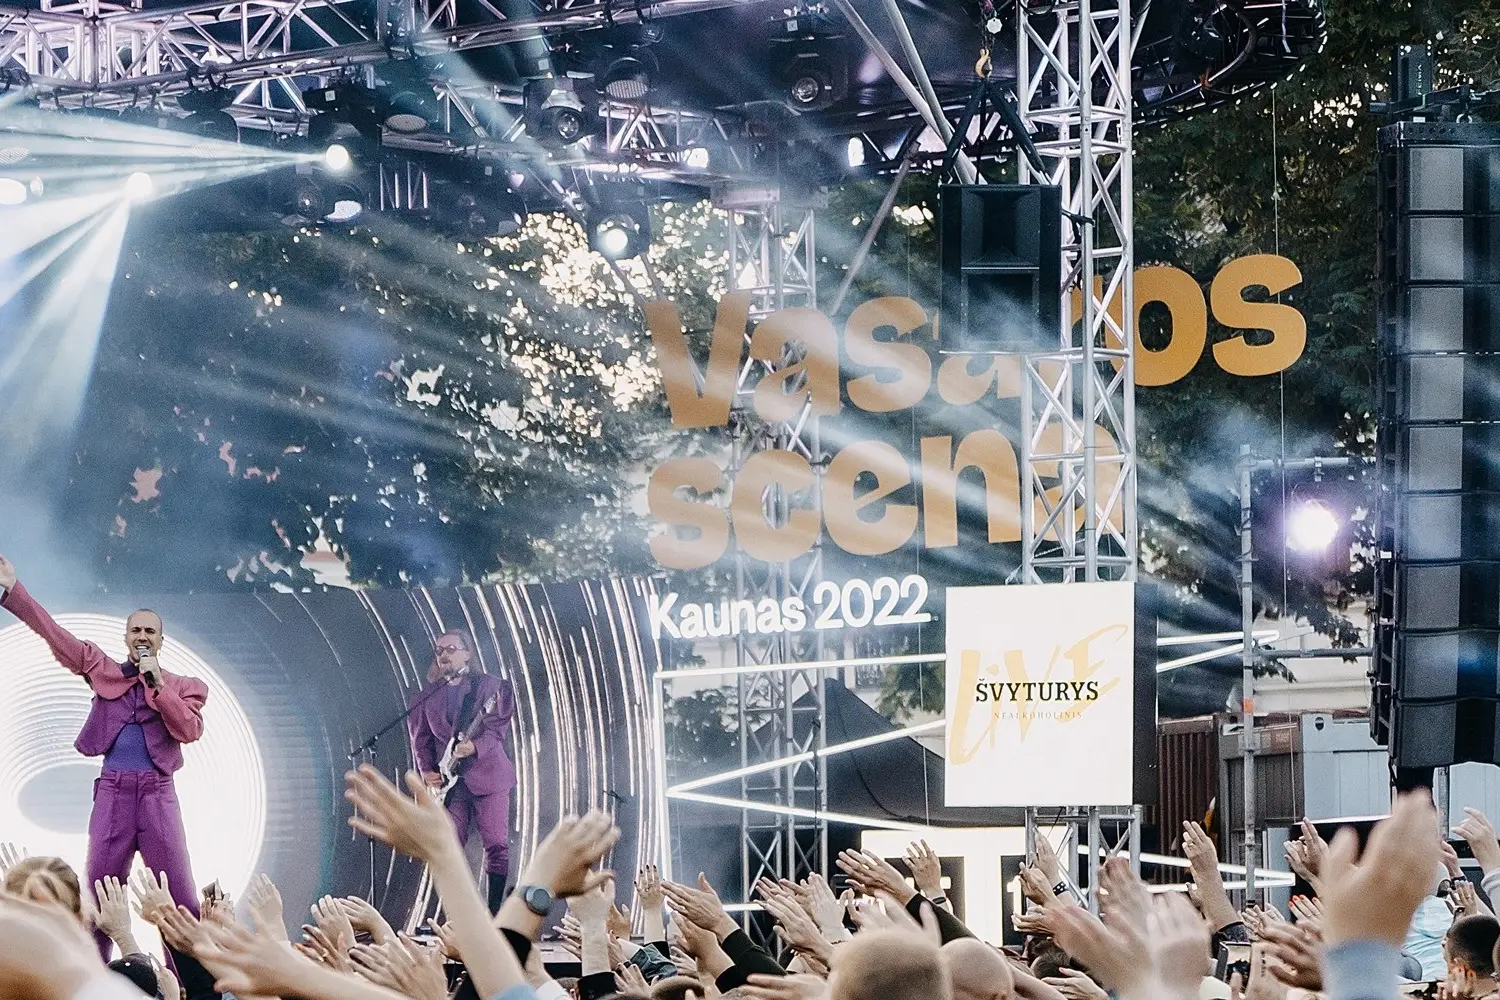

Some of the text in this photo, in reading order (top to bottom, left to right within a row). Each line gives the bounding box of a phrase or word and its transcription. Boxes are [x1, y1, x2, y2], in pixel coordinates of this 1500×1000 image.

[644, 253, 1307, 429] Vasos
[650, 574, 931, 640] Kaunas 2022
[975, 677, 1099, 702] ŠVYTURYS
